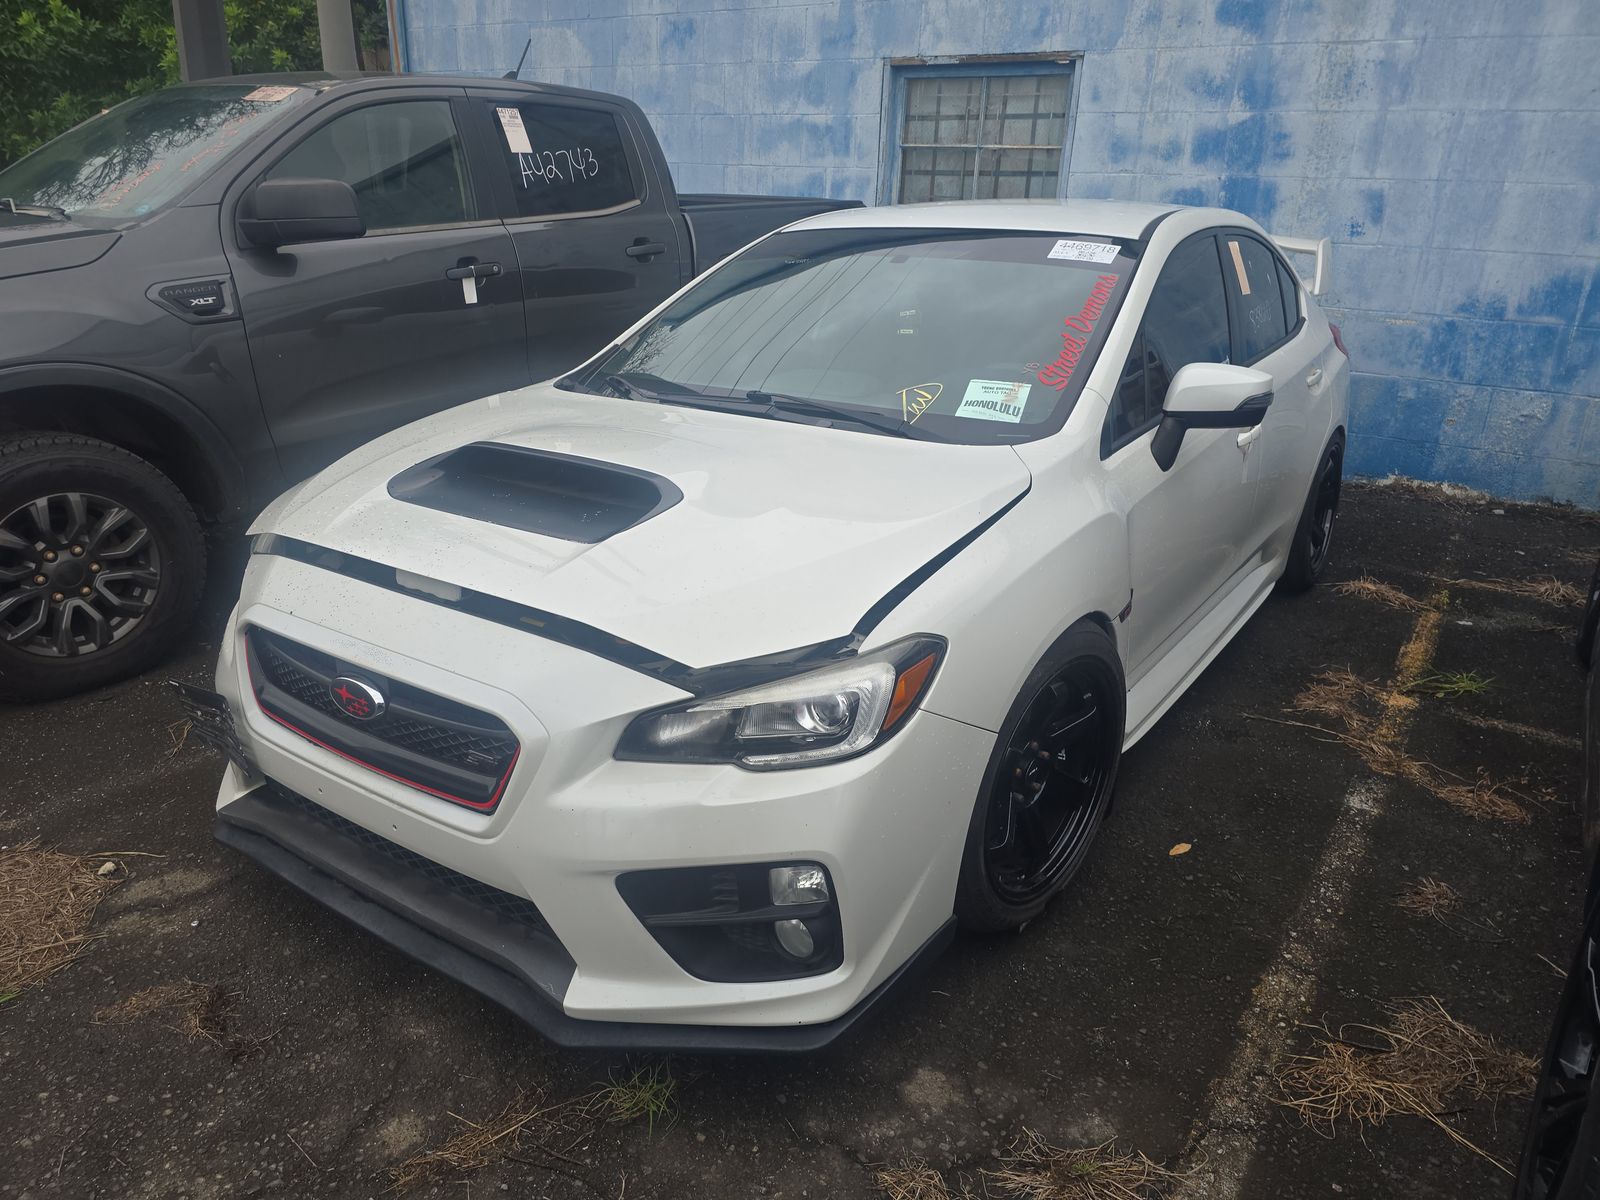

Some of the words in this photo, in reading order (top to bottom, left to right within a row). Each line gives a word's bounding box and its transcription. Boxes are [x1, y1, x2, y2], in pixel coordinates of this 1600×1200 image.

[519, 147, 599, 189] A42743
[1059, 242, 1117, 254] 4469718
[189, 296, 217, 306] XLT
[1037, 333, 1088, 392] Street
[1064, 272, 1120, 333] Demons
[963, 400, 1021, 416] HONOLULU
